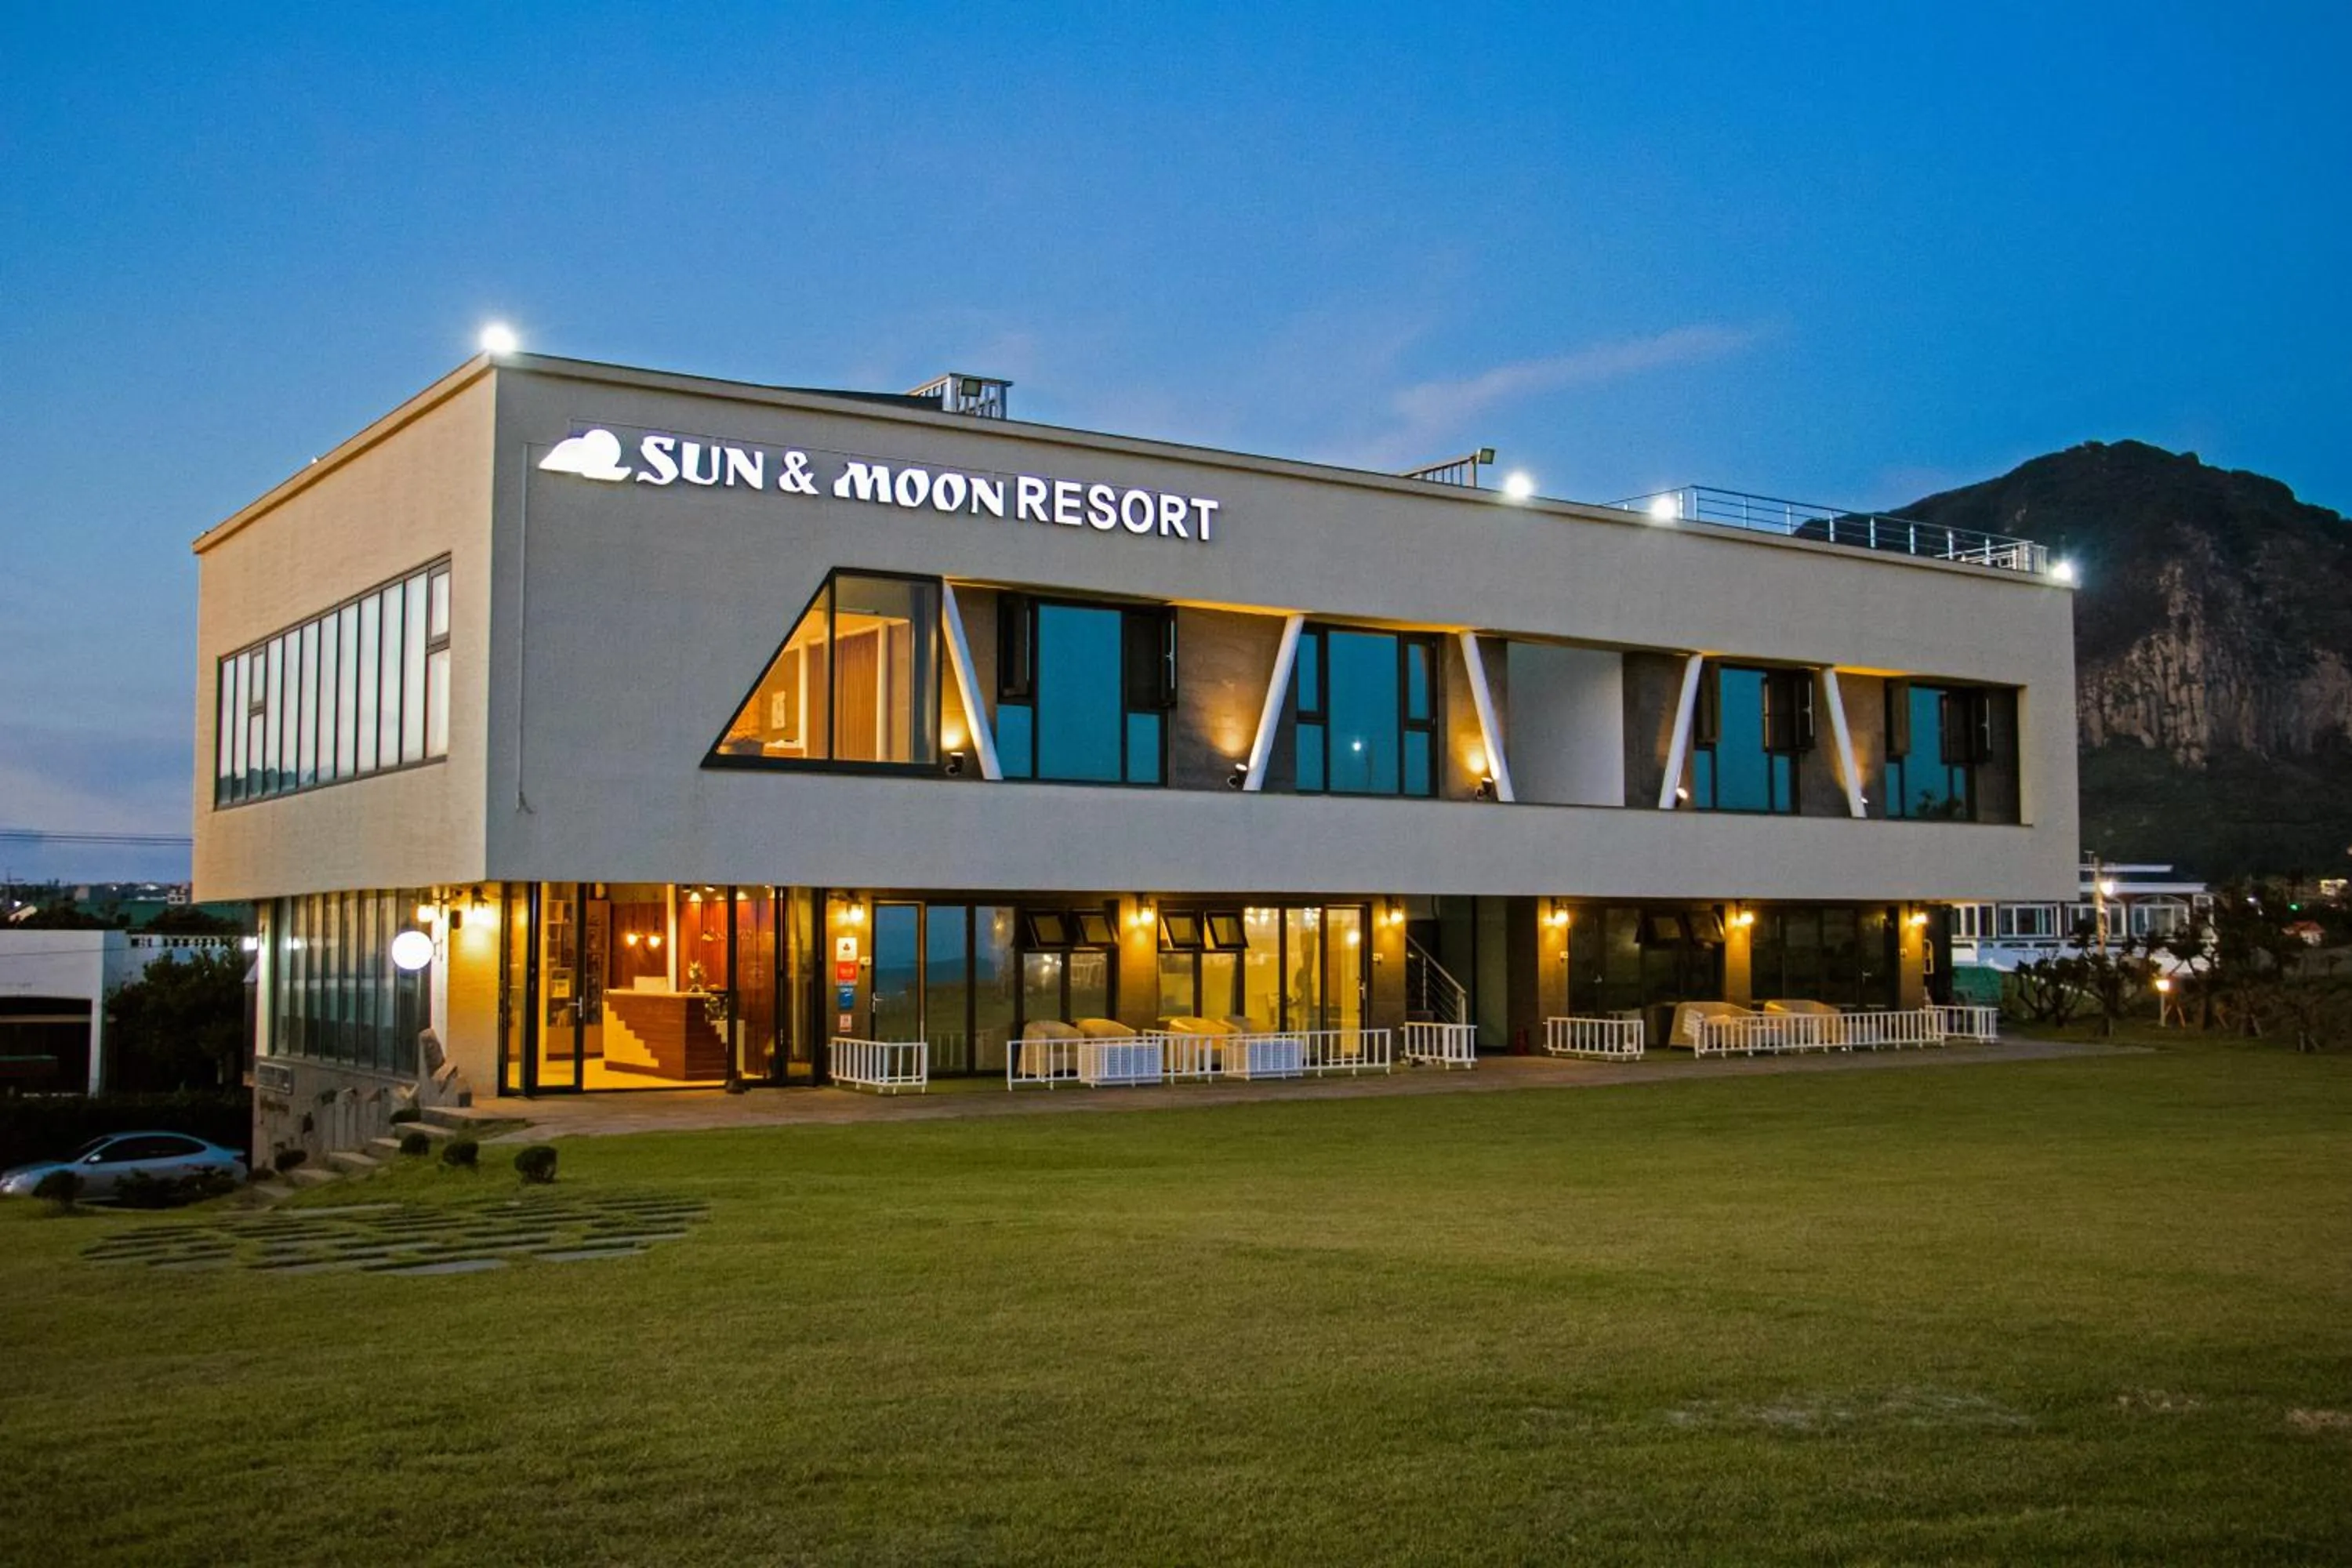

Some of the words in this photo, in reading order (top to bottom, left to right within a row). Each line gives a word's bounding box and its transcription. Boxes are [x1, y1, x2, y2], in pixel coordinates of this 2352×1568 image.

[636, 435, 764, 489] SUN
[779, 451, 819, 495] &
[833, 461, 1004, 517] MOON
[1017, 475, 1219, 541] RESORT
